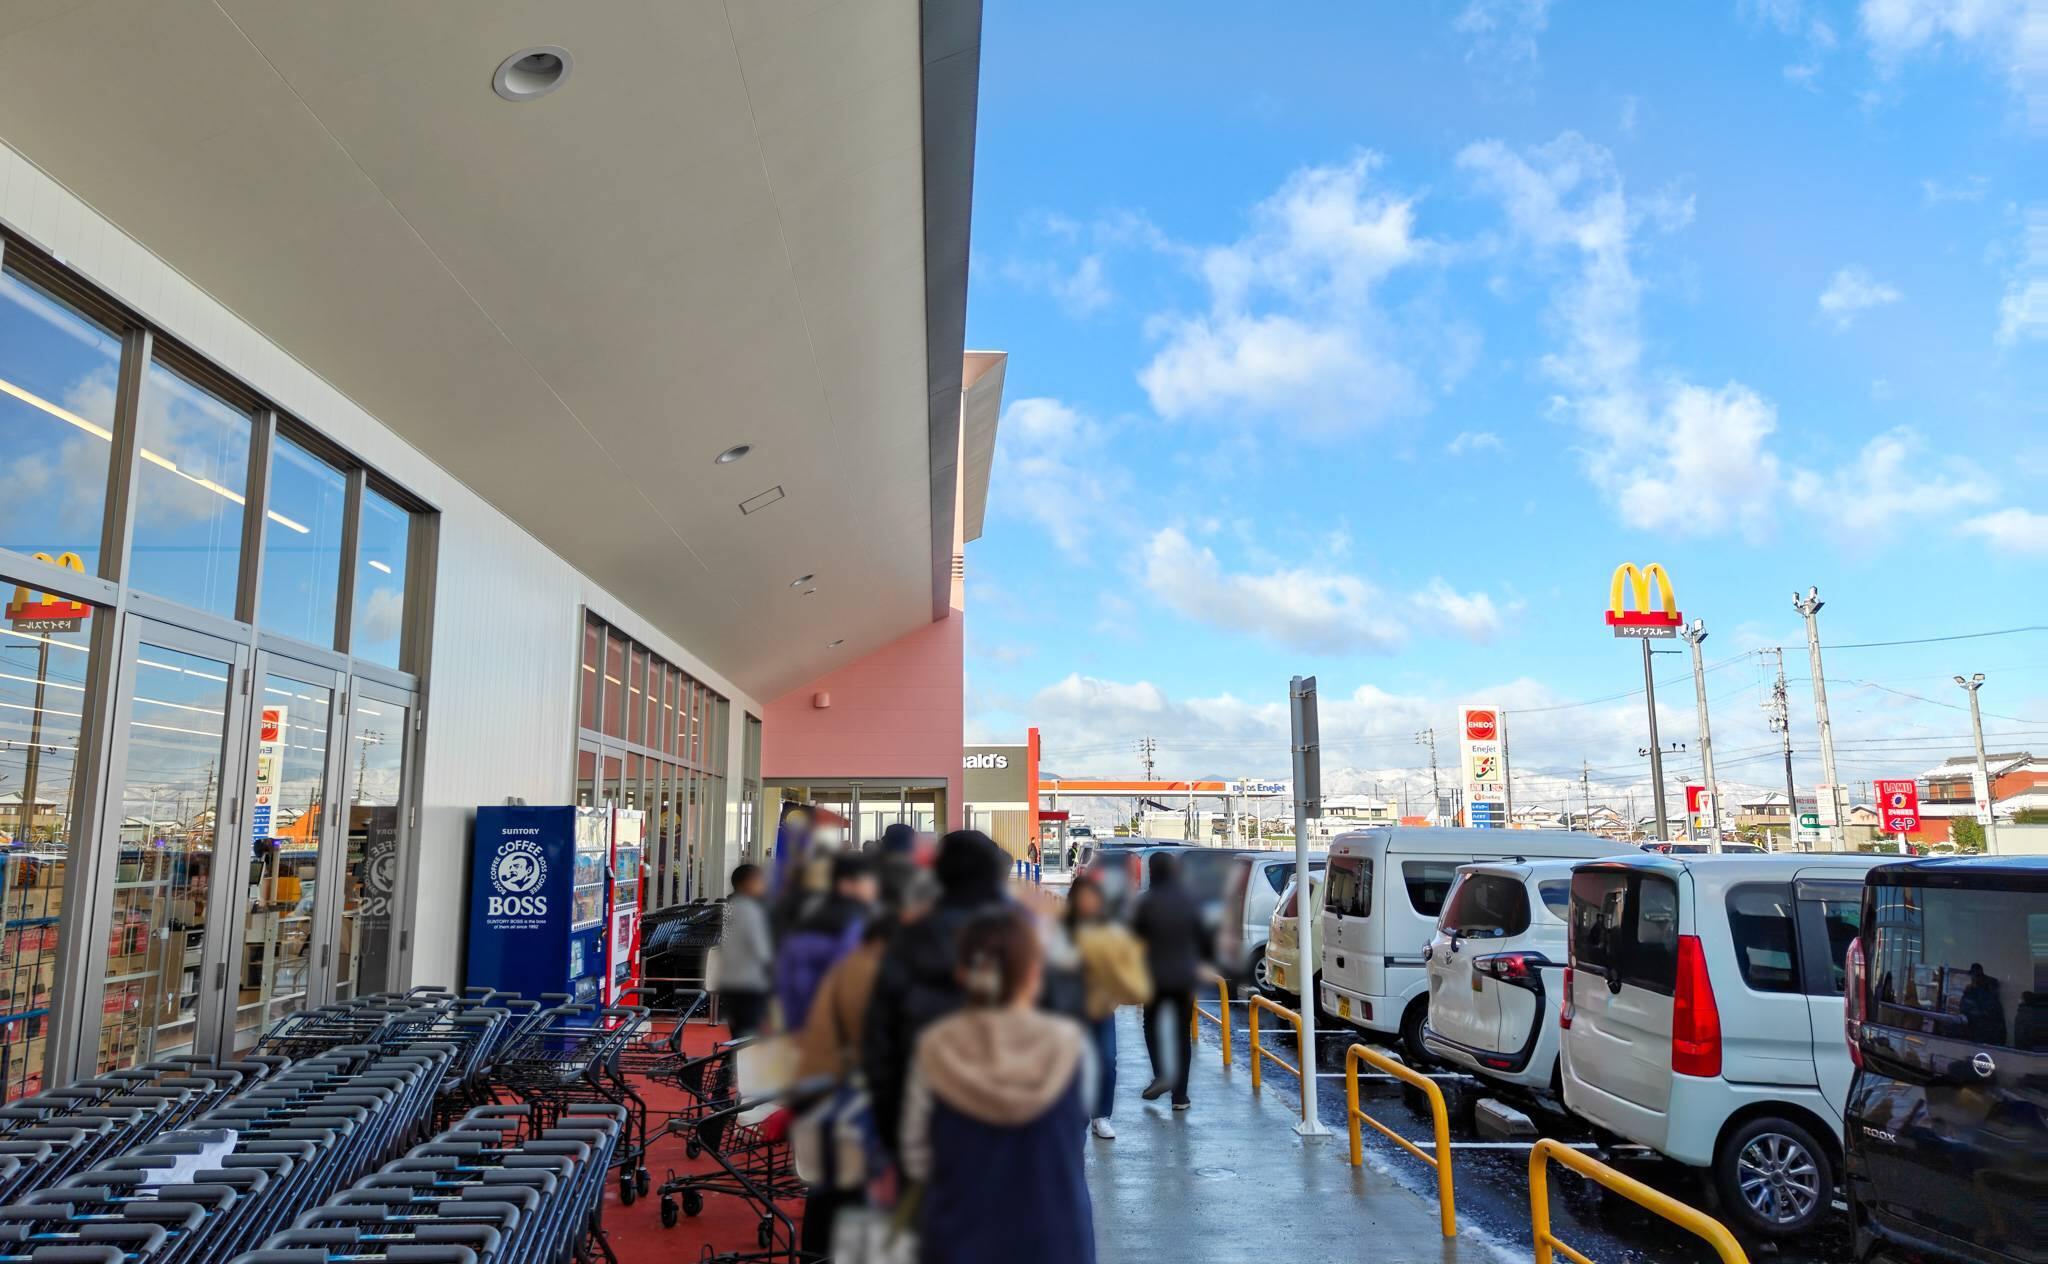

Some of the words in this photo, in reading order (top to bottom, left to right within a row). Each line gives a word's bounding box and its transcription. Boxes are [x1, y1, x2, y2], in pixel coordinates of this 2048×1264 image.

[1623, 627, 1671, 636] ドライブスルー
[1468, 721, 1494, 729] ENEOS
[1472, 745, 1496, 753] EneJet
[1257, 783, 1287, 793] EneJet
[1883, 782, 1912, 794] LAMU
[1904, 818, 1916, 831] P
[497, 840, 543, 857] COFFEE
[490, 856, 501, 880] COFFEE
[538, 856, 548, 873] BOSS
[493, 880, 507, 895] BOSS
[487, 896, 547, 916] BOSS
[1863, 1126, 1896, 1143] ROOX
